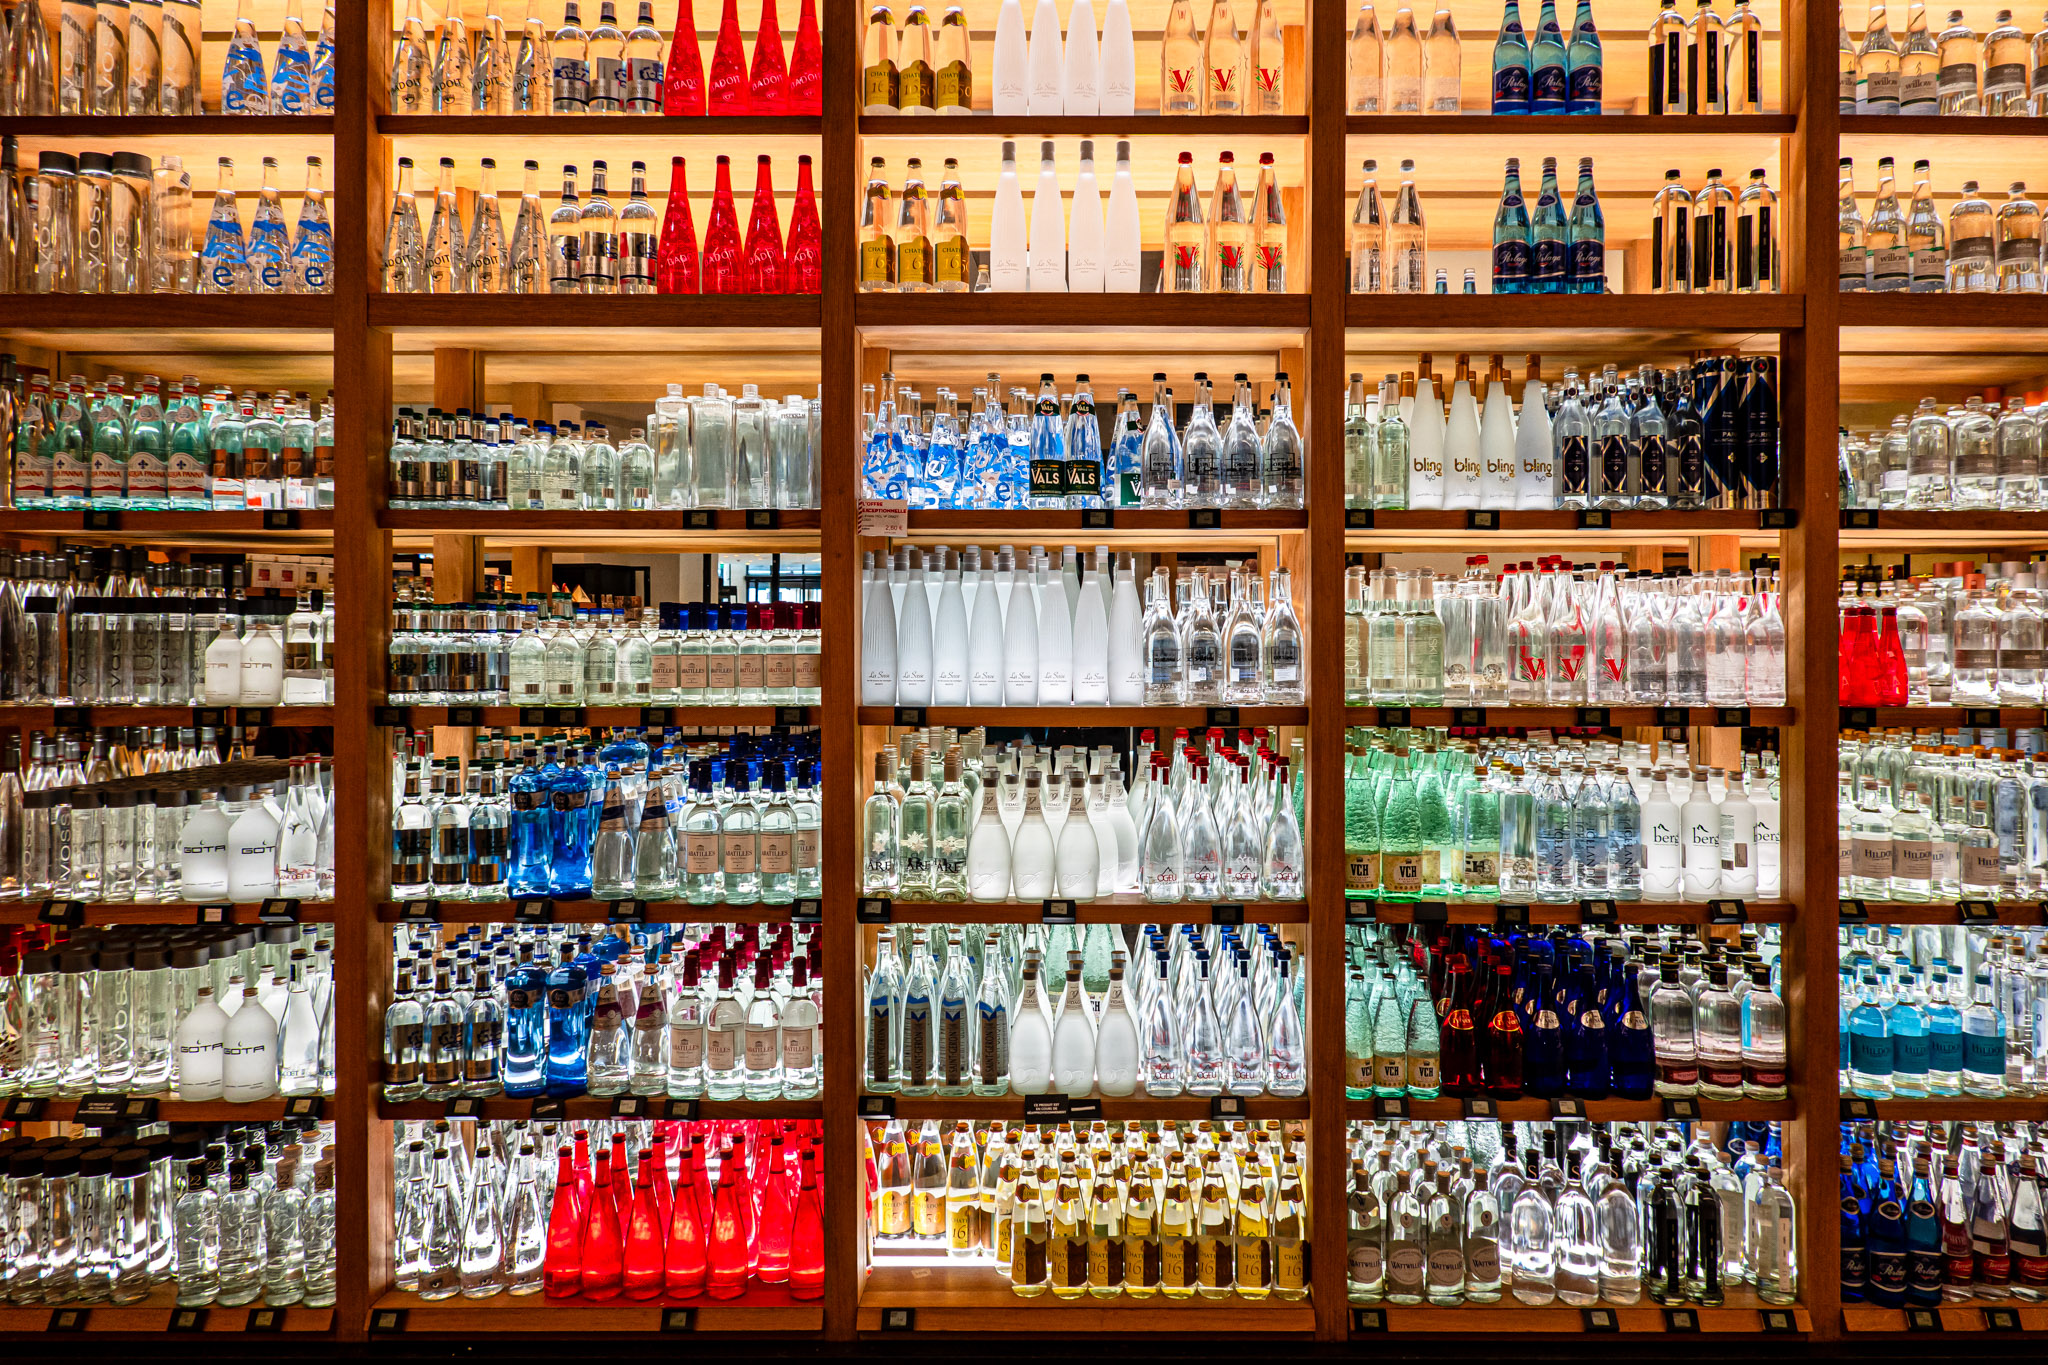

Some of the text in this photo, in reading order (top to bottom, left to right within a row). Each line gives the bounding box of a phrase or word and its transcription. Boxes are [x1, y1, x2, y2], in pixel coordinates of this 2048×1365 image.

[1172, 69, 1190, 93] V
[1213, 68, 1233, 92] V
[1259, 68, 1278, 92] V
[1873, 77, 1898, 86] willow
[1905, 79, 1933, 90] willow
[1178, 245, 1197, 270] V
[1222, 245, 1242, 269] V
[1260, 246, 1279, 270] V
[1879, 253, 1906, 263] willow
[212, 264, 235, 287] e
[261, 265, 283, 287] e
[304, 264, 326, 287] e
[61, 470, 84, 478] PANNA
[98, 470, 121, 478] PANNA
[1413, 457, 1443, 477] bling
[1454, 457, 1481, 477] bling
[1487, 458, 1515, 478] bling
[1523, 458, 1553, 478] bling
[1030, 467, 1060, 485] VALS
[1067, 467, 1096, 485] VALS
[995, 481, 1011, 501] e
[110, 622, 122, 687] VOSS
[1522, 658, 1544, 682] V
[1562, 658, 1580, 682] V
[1605, 658, 1624, 682] V
[1653, 825, 1680, 847] berg
[1693, 826, 1720, 848] berg
[60, 811, 72, 881] VOSS
[184, 844, 226, 854] GOTA
[241, 845, 276, 855] GOT
[1157, 873, 1177, 882] OGEU
[1194, 872, 1215, 881] OGEU
[1234, 872, 1256, 881] OGEU
[1276, 872, 1297, 881] OGEU
[1350, 863, 1369, 876] VCH
[1400, 865, 1417, 877] VCH
[180, 1042, 224, 1054] GOTA
[1154, 1072, 1174, 1080] OGEU
[1197, 1071, 1217, 1079] OGEU
[1235, 1071, 1255, 1079] OGEU
[1275, 1071, 1297, 1079] OGEU
[1384, 1066, 1399, 1076] VCH
[1419, 1067, 1434, 1078] VCH
[1527, 1164, 1537, 1179] S
[1571, 1164, 1580, 1179] S
[1472, 1258, 1499, 1267] WATTWILLE
